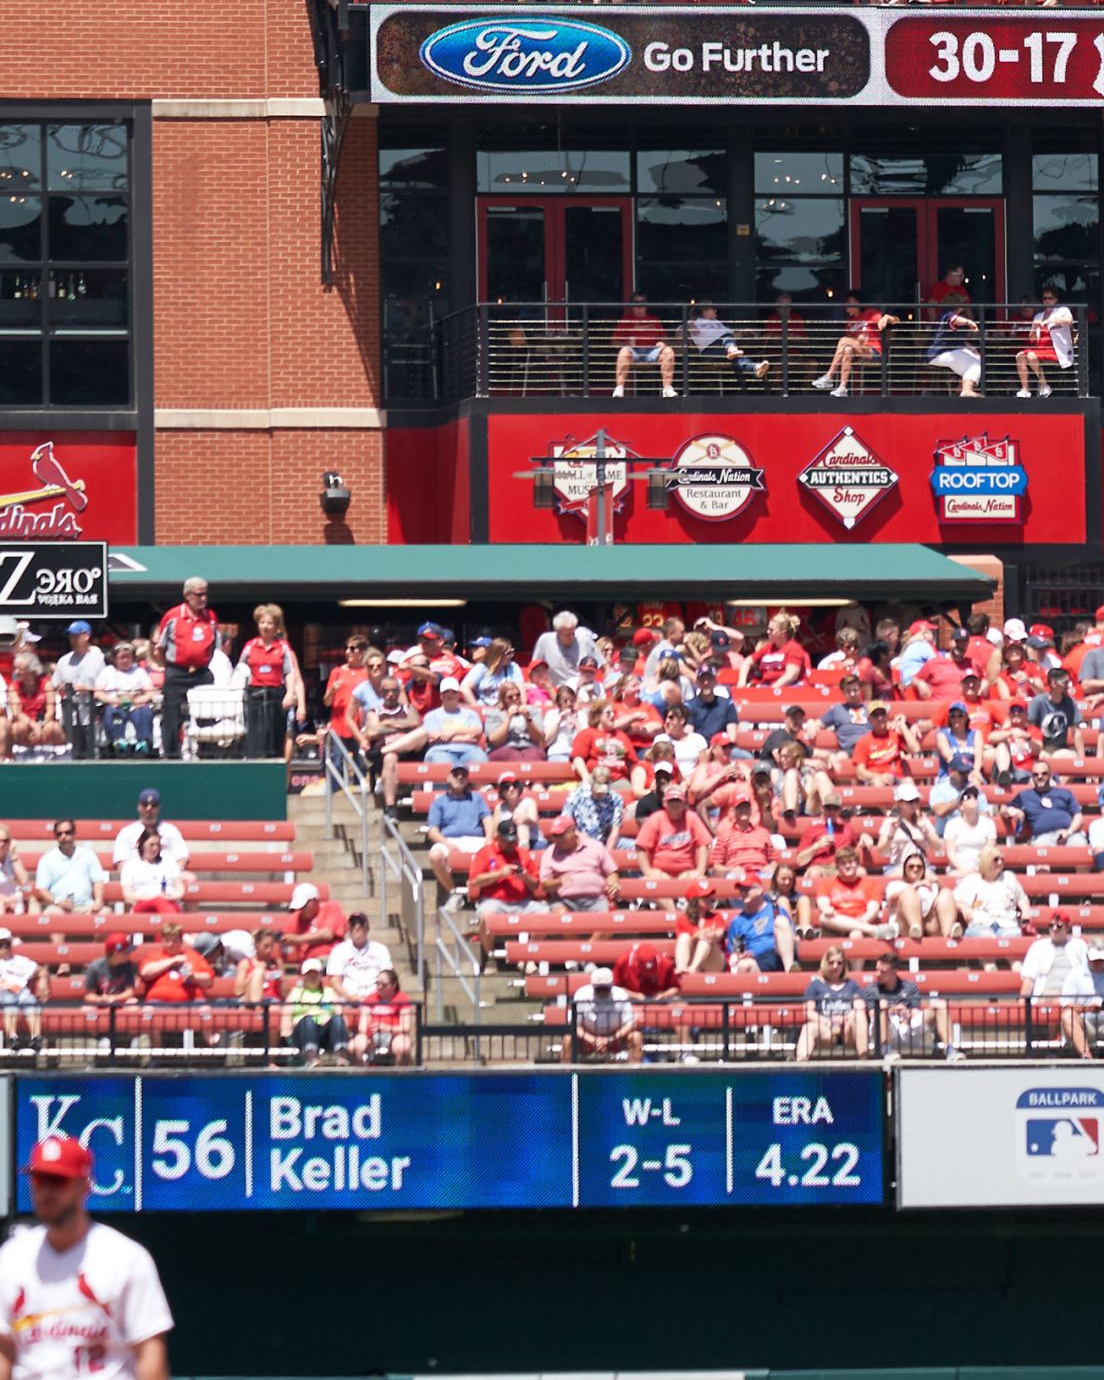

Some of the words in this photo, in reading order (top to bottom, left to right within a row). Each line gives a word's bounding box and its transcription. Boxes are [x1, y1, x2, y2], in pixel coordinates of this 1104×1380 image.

[464, 25, 588, 79] Ford
[644, 41, 694, 74] Go
[702, 41, 830, 74] Further
[928, 31, 1077, 84] 30-17
[823, 449, 878, 469] Cardinals
[717, 468, 751, 484] Nation
[810, 471, 888, 484] AUTHENTICS
[939, 472, 1020, 488] ROOFTOP
[686, 488, 741, 499] Restaurant
[700, 501, 708, 509] &
[711, 501, 728, 509] Bar
[833, 487, 865, 506] Shop
[947, 499, 982, 513] Cardinals
[982, 499, 1013, 513] Nation
[622, 1098, 681, 1126] W-L
[772, 1097, 834, 1125] ERA
[1029, 1092, 1098, 1106] BALLPARK
[269, 1093, 381, 1140] Brad
[151, 1119, 235, 1180] 56
[269, 1146, 410, 1192] Keller
[610, 1143, 693, 1188] 2-5
[755, 1142, 861, 1187] 4.22
